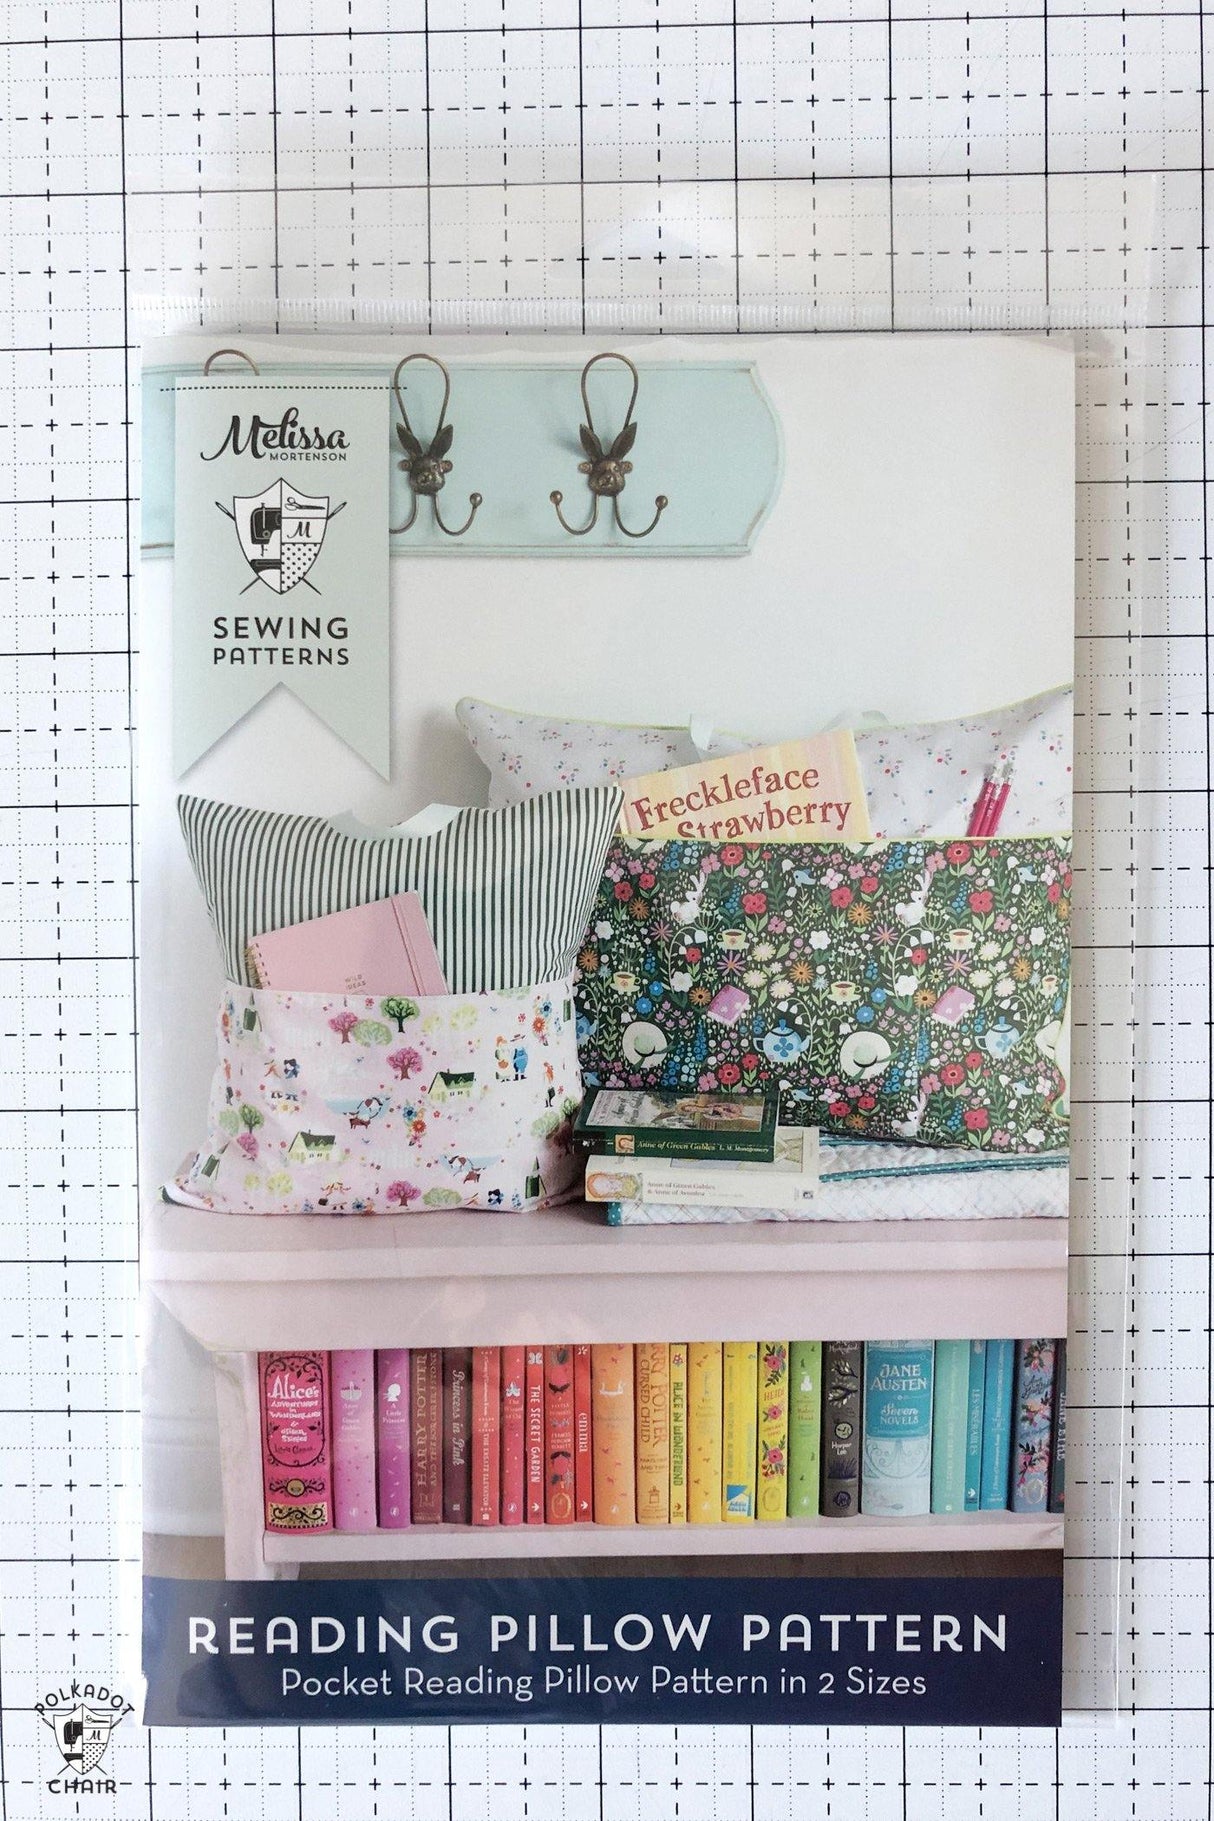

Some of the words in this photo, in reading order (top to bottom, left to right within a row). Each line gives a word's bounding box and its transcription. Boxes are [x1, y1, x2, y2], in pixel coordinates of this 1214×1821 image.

[200, 406, 350, 461] Melissa
[269, 452, 347, 461] MORTENSON
[287, 521, 313, 538] M
[213, 616, 349, 639] SEWING
[213, 648, 349, 665] PATTERNS
[631, 766, 820, 831] Freckleface
[677, 800, 852, 839] Strawberry
[637, 1140, 656, 1149] Anne
[657, 1141, 666, 1150] of
[666, 1141, 688, 1150] Green
[690, 1142, 716, 1152] Gables
[267, 1373, 320, 1400] Alice's
[416, 1353, 427, 1418] POTTER
[640, 1359, 650, 1404] CURSED
[870, 1378, 928, 1391] AUSTEN
[880, 1364, 921, 1379] JANE
[453, 1370, 465, 1418] Princess
[530, 1385, 541, 1403] THE
[453, 1422, 463, 1434] in
[530, 1407, 541, 1442] SECRET
[641, 1406, 650, 1443] CHILD
[651, 1384, 668, 1448] POTTER
[880, 1415, 919, 1426] NOVELS
[416, 1422, 427, 1487] HARRY
[452, 1437, 465, 1467] Pink
[831, 1441, 853, 1450] Harper
[530, 1446, 541, 1483] GARDEN
[188, 1614, 459, 1655] READING
[491, 1613, 712, 1653] PILLOW
[743, 1613, 1007, 1653] PATTERN
[281, 1666, 392, 1697] Pocket
[404, 1665, 534, 1702] Reading
[545, 1663, 640, 1695] Pillow
[652, 1665, 768, 1695] Pattern
[781, 1667, 807, 1695] in
[818, 1673, 835, 1695] 2
[846, 1665, 928, 1696] Sizes
